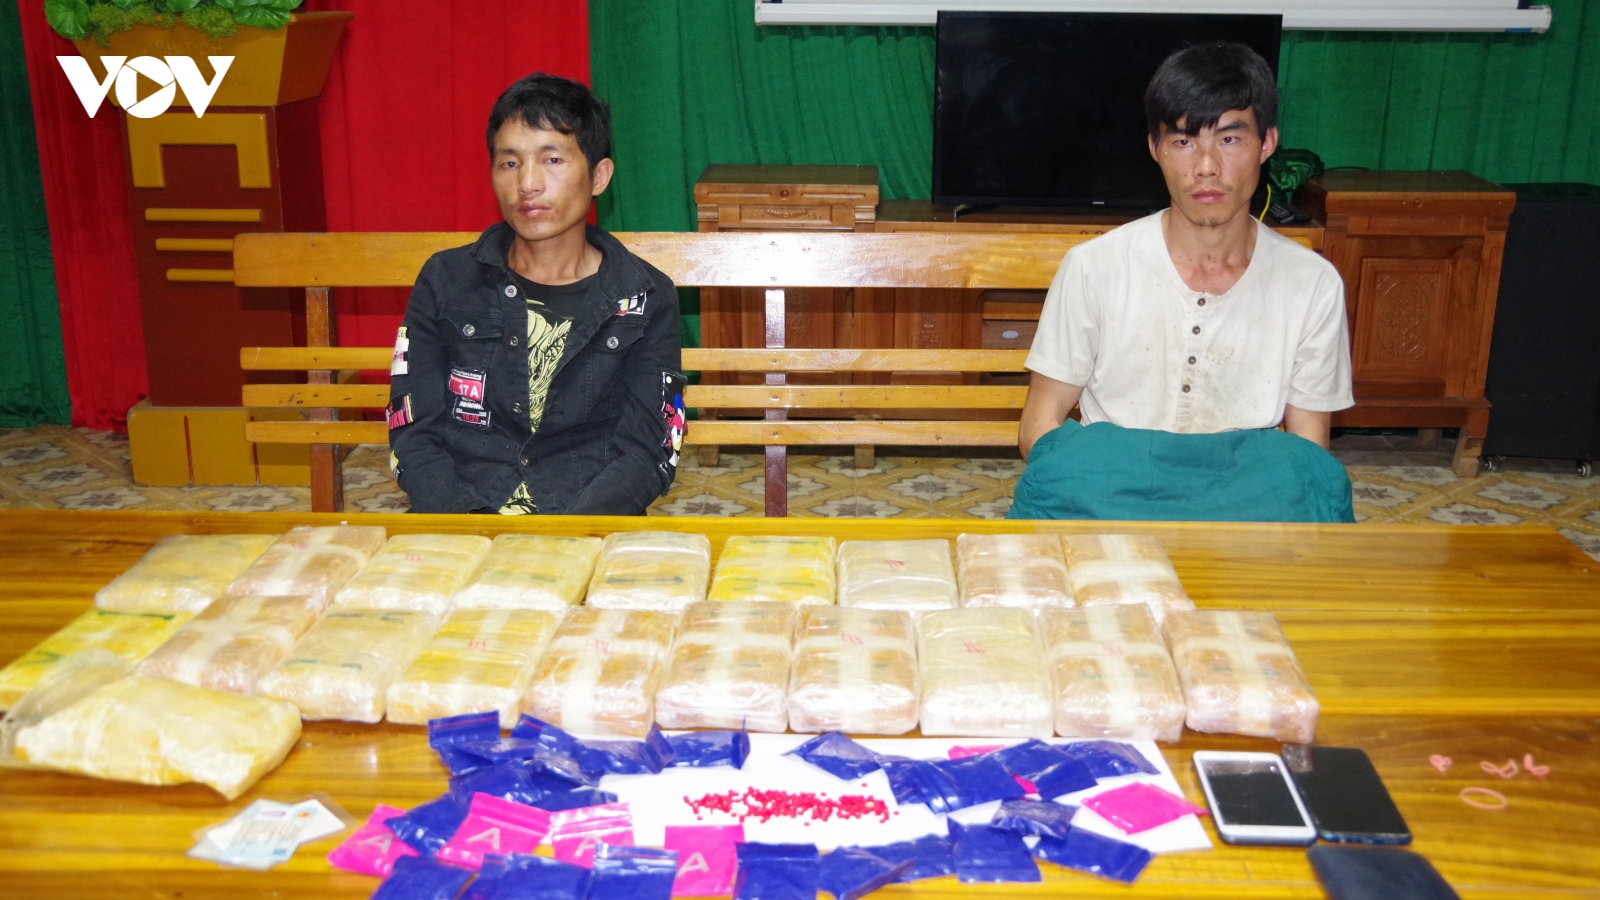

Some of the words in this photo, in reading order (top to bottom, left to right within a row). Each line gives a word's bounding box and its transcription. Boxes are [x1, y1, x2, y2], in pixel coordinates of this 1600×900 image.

[356, 833, 393, 854] A
[465, 827, 501, 850] A
[676, 851, 710, 878] A
